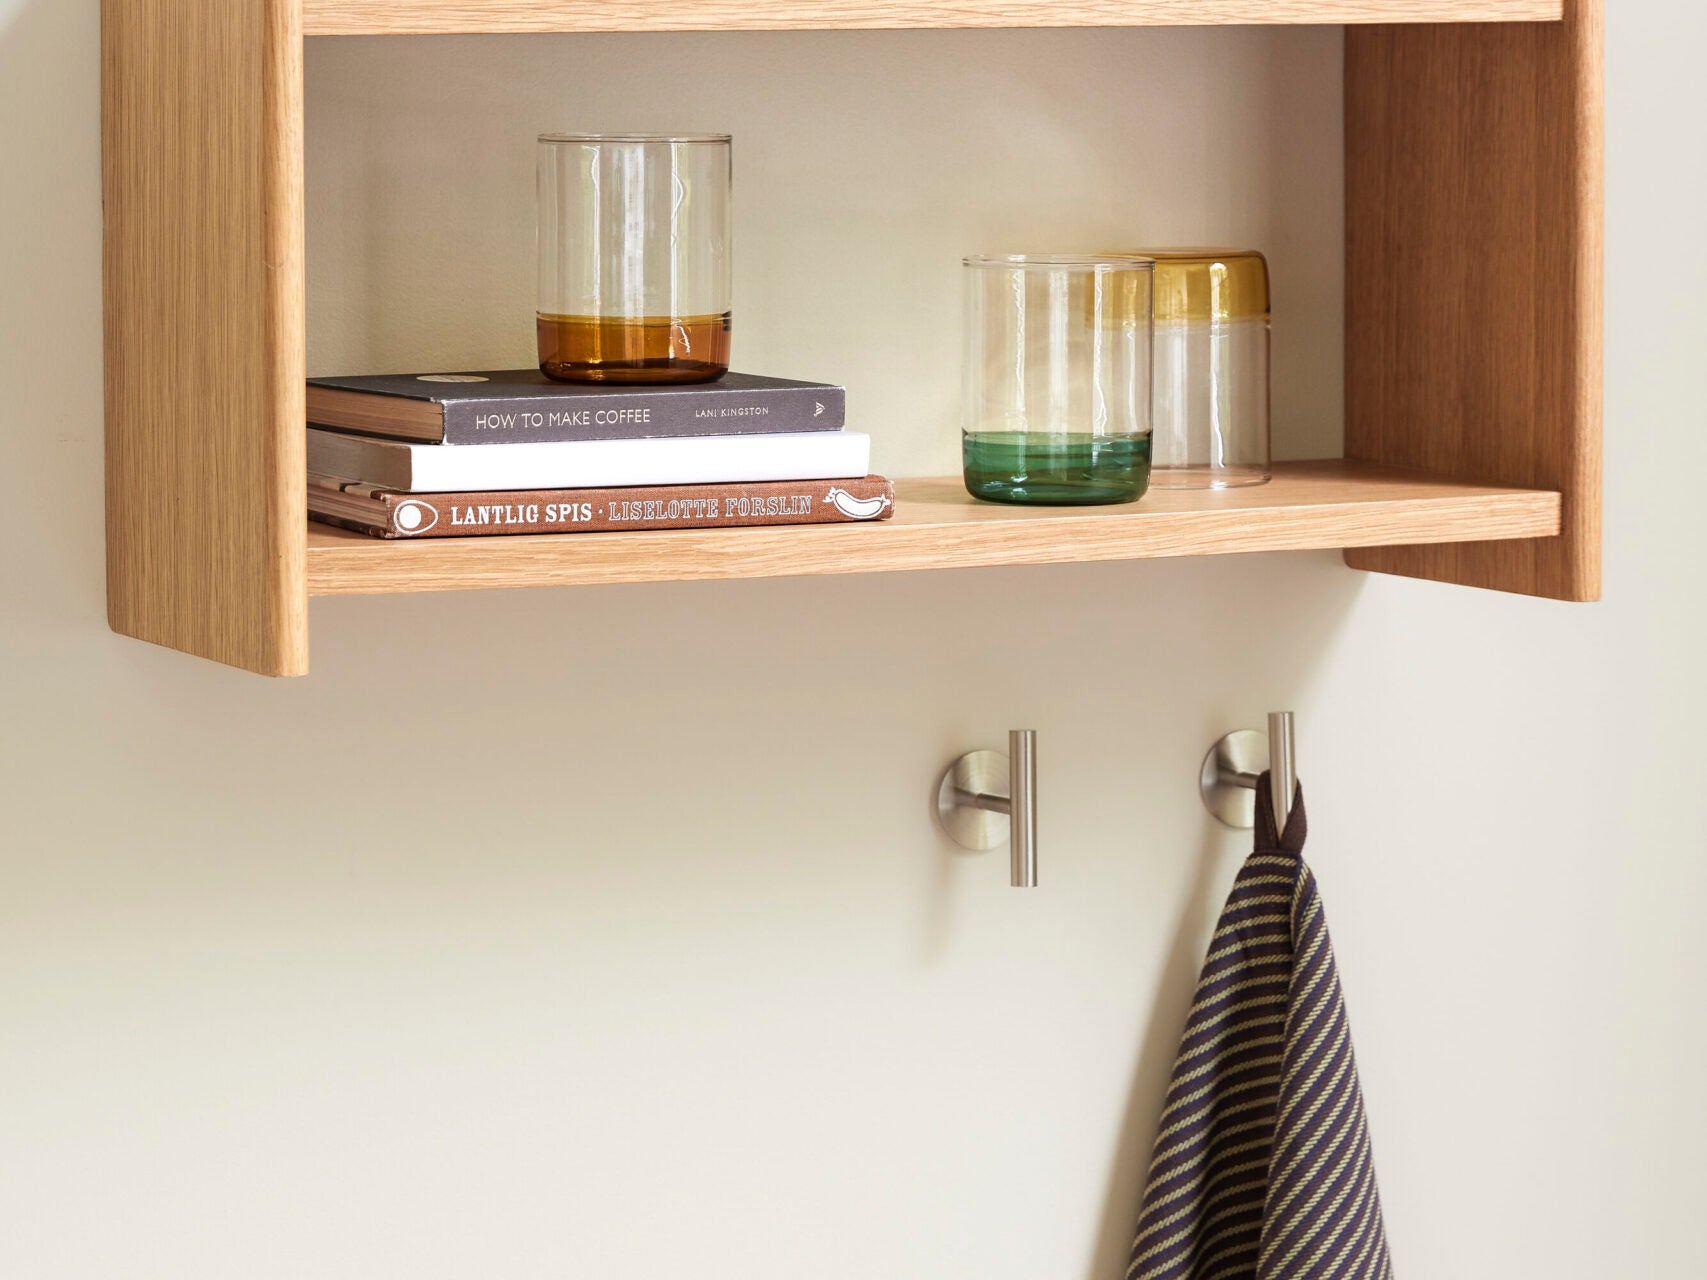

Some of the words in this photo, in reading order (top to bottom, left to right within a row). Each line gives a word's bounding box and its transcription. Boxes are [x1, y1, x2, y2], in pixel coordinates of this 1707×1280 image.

[476, 414, 516, 430] HOW
[522, 413, 543, 427] TO
[549, 412, 590, 427] MAKE
[595, 409, 651, 424] COFFEE
[695, 409, 717, 418] LANI
[721, 407, 769, 417] KINGSTON
[451, 505, 539, 525] LANTLIG
[545, 503, 592, 523] SPIS
[609, 501, 718, 521] LISELOTTE
[726, 496, 813, 516] FORSLIN
